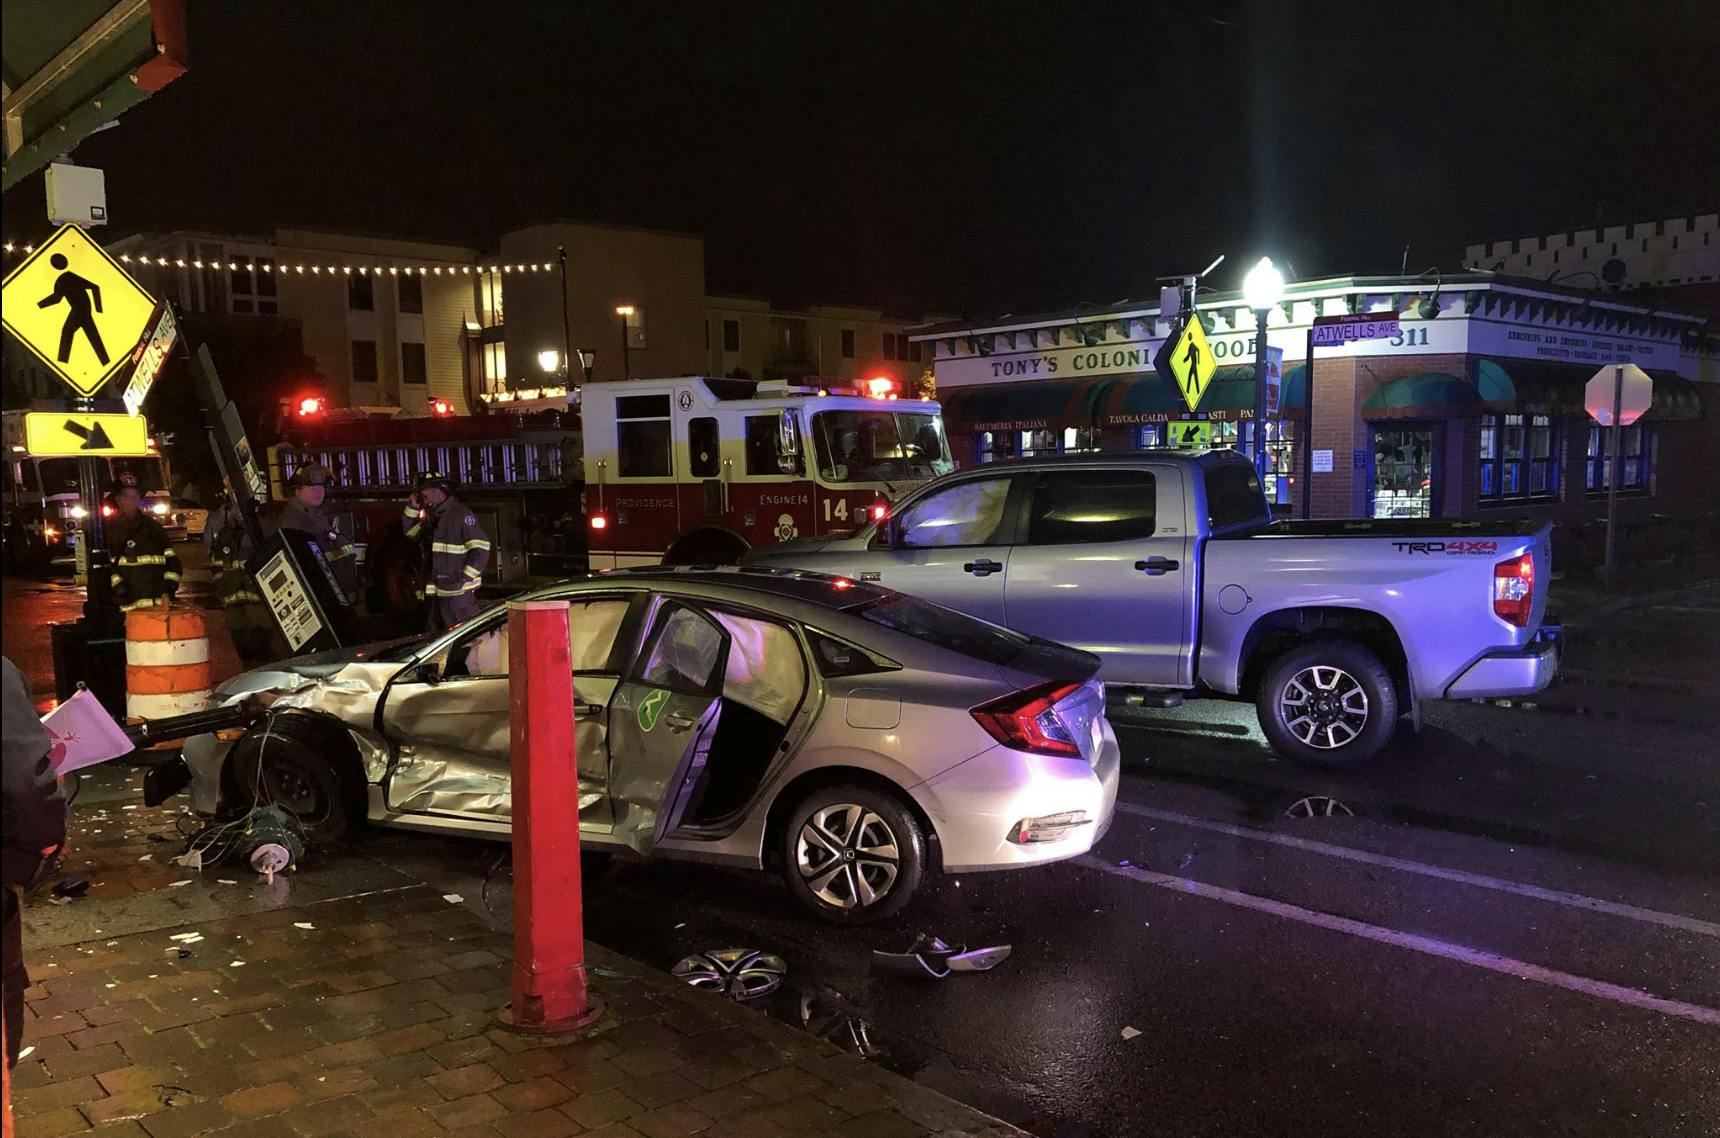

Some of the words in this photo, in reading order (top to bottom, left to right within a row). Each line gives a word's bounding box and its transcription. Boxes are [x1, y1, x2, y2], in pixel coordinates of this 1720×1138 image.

[1316, 323, 1376, 341] ATWELLS
[1379, 322, 1397, 333] AVE
[1390, 327, 1430, 347] 311
[992, 356, 1058, 377] TONY'S
[1073, 349, 1149, 371] COLONI
[1208, 338, 1257, 359] OOD
[1109, 415, 1140, 424] TAVOLA
[1141, 413, 1169, 423] CALDA
[1208, 410, 1226, 420] ASTI
[1015, 420, 1048, 429] ITALIANA
[616, 497, 675, 508] PROVIDENCE
[760, 494, 796, 506] ENGINE
[798, 494, 809, 505] 14
[823, 498, 849, 522] 14
[1392, 542, 1446, 555] TRD
